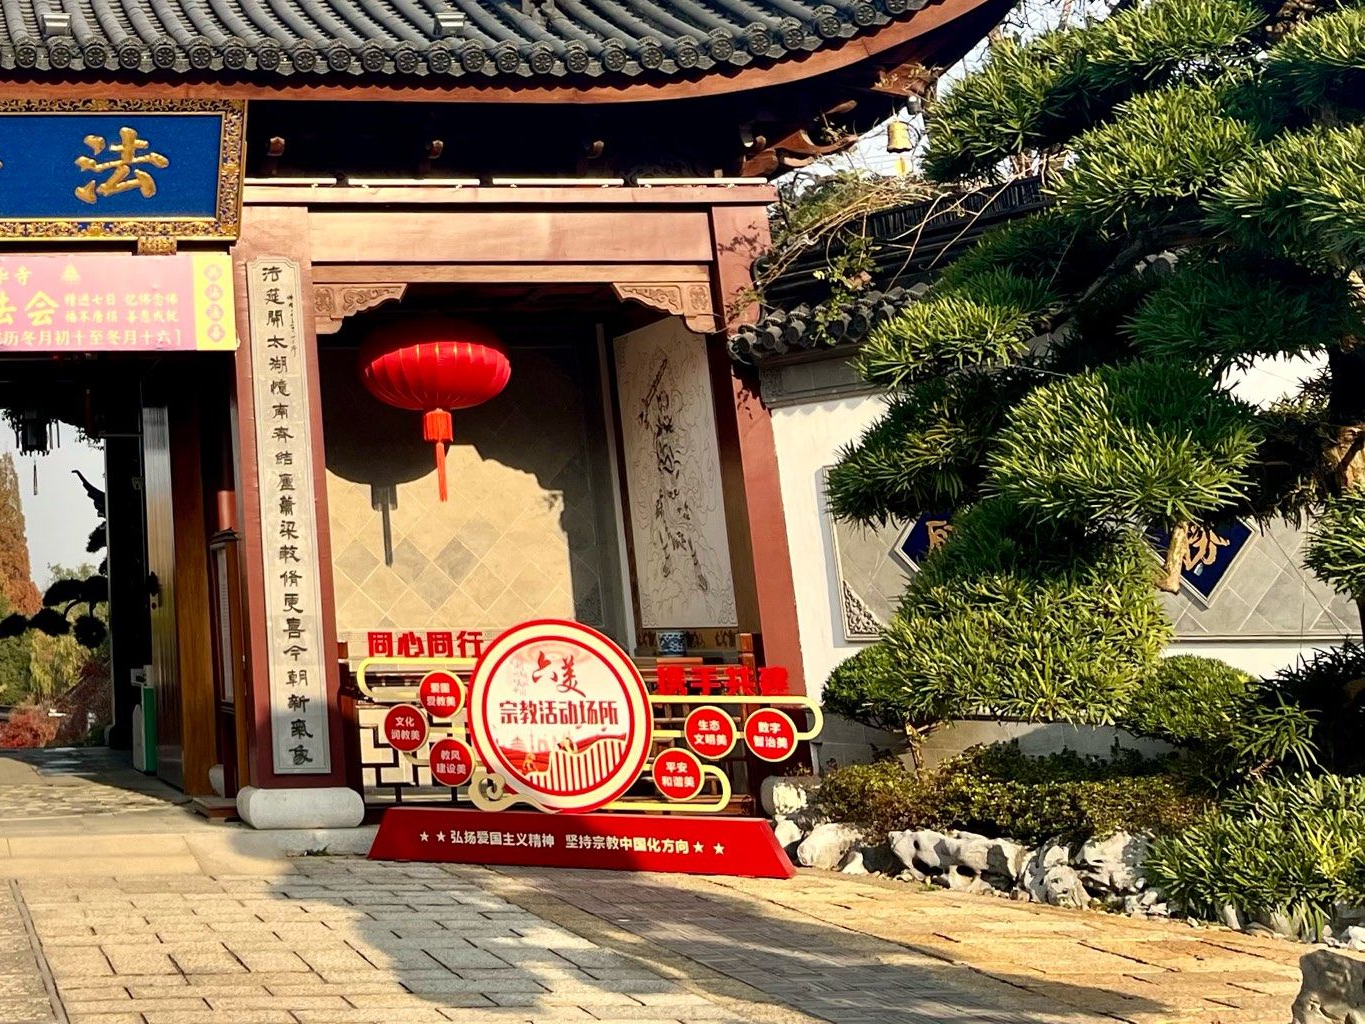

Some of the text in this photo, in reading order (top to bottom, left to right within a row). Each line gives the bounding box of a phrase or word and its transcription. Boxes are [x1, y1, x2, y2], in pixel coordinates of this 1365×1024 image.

[368, 631, 483, 658] 同心同行
[532, 651, 586, 698] 六美
[500, 700, 619, 725] 宗教活动场所
[395, 716, 415, 727] 文化
[698, 720, 721, 731] 生态
[758, 722, 782, 734] 数字
[694, 733, 728, 746] 文明美
[436, 763, 467, 775] 建设美
[665, 761, 688, 773] 平安
[661, 775, 696, 788] 和谐美
[450, 830, 690, 854] 弘扬爱国主义精神 坚持宗教中国化方向
